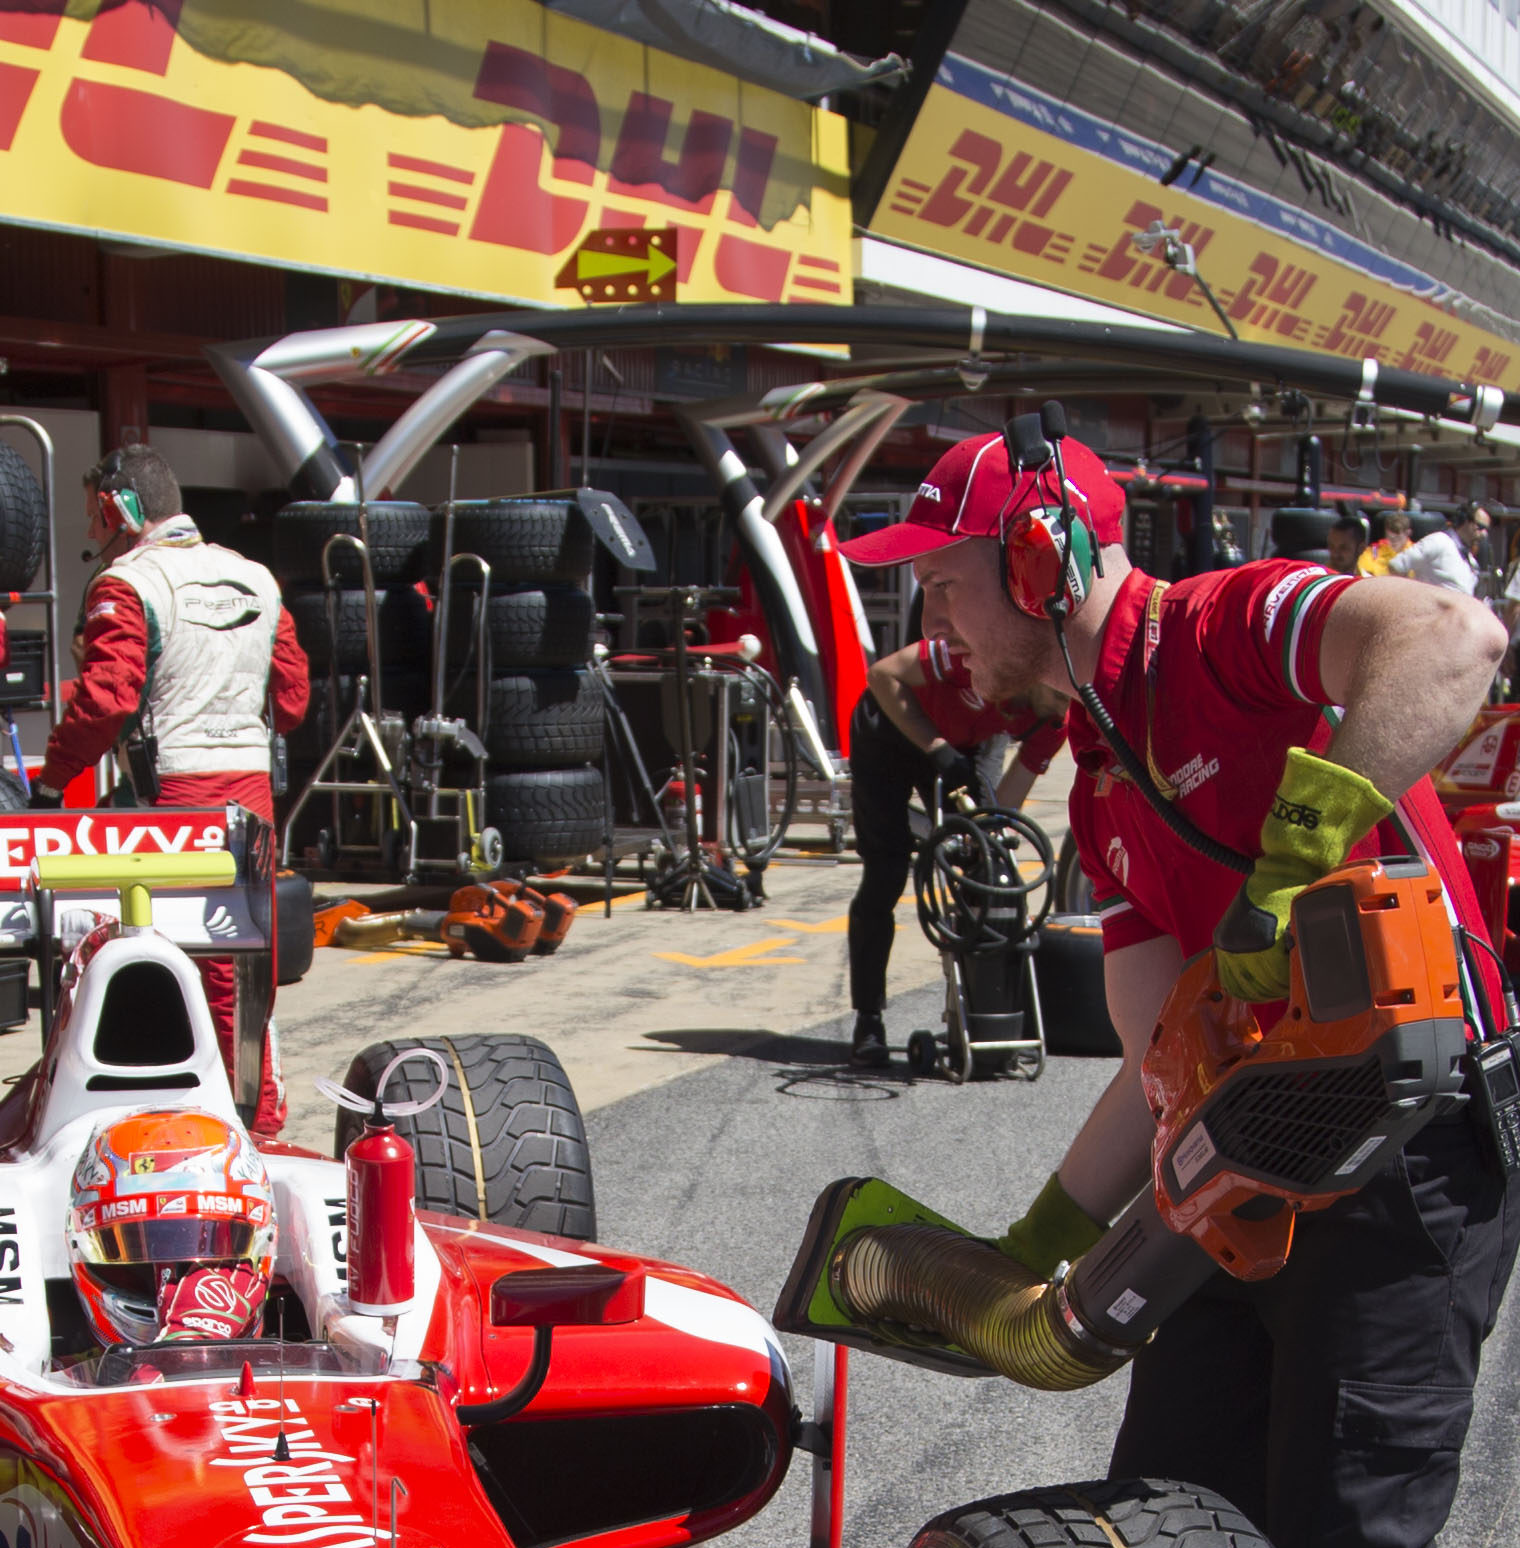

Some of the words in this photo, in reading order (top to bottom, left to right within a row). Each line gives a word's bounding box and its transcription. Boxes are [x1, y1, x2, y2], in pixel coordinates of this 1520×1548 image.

[469, 40, 792, 301] DHL
[917, 127, 1075, 256] DHL
[1098, 200, 1215, 301] DHL
[1228, 251, 1318, 337] DHL
[1326, 291, 1398, 359] DHL
[1054, 537, 1084, 607] PEMA
[1179, 757, 1220, 800] RACING
[101, 1198, 147, 1221] MSM
[197, 1194, 243, 1214] MSM
[182, 1317, 232, 1334] sparco
